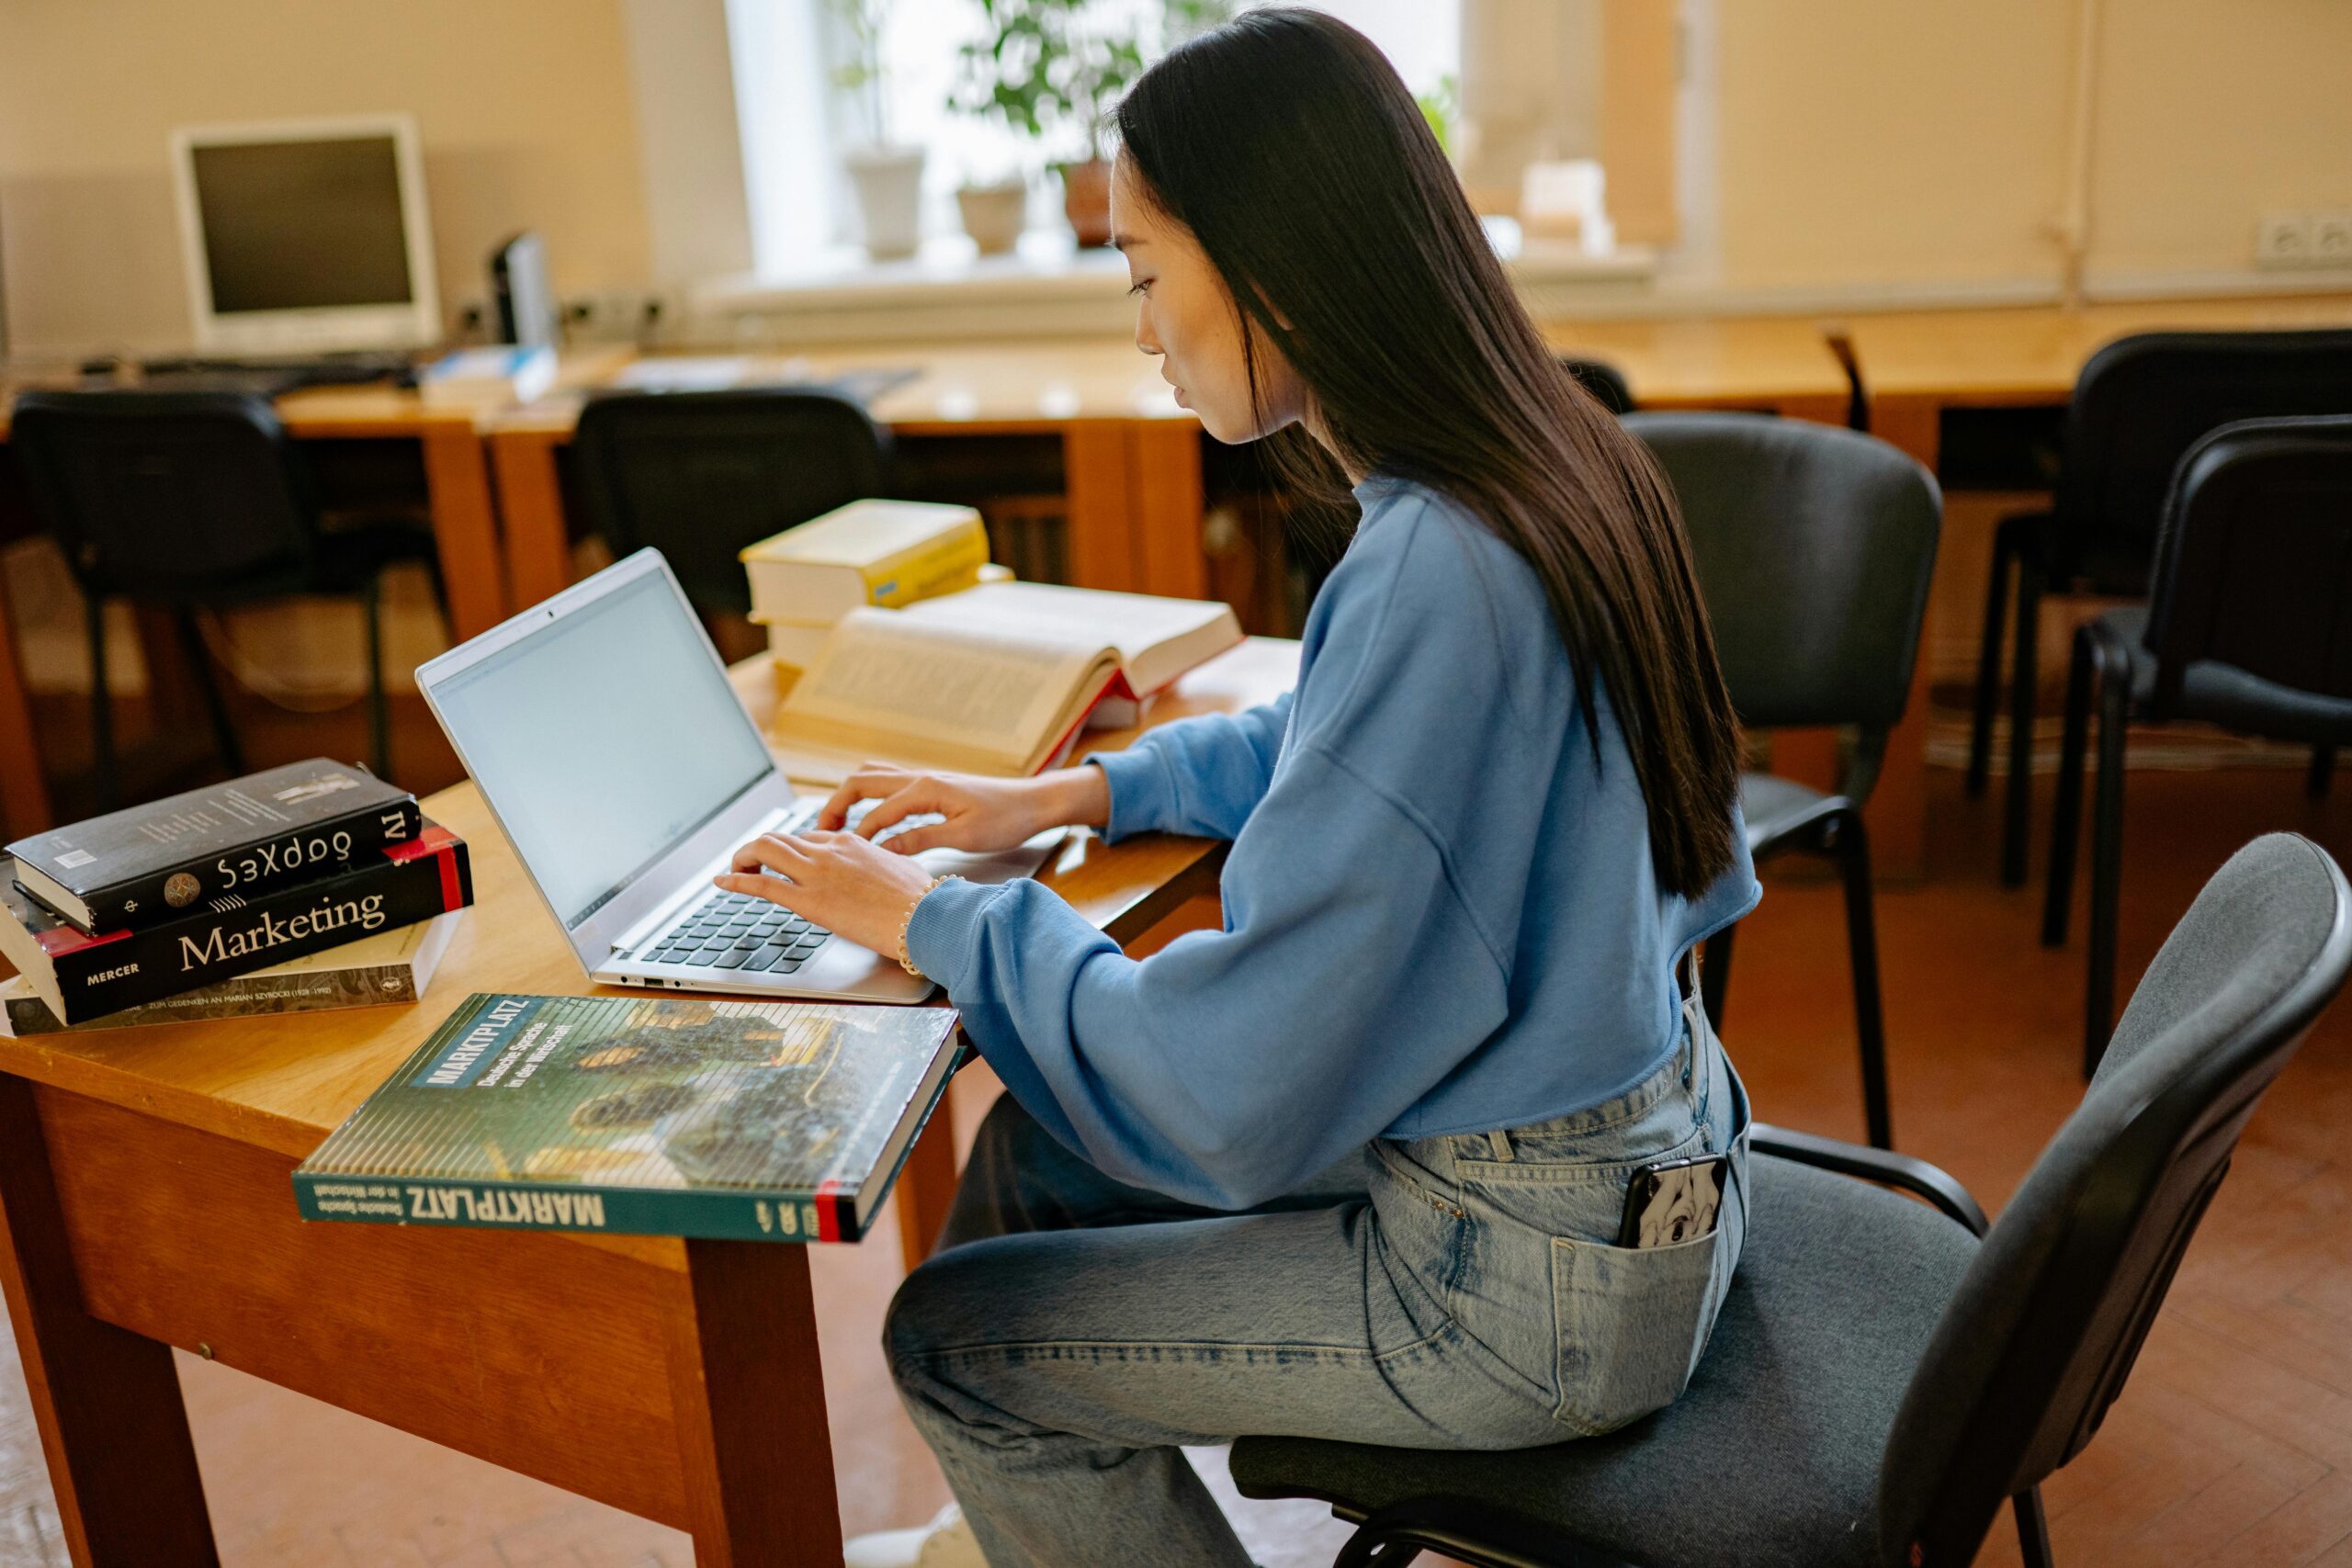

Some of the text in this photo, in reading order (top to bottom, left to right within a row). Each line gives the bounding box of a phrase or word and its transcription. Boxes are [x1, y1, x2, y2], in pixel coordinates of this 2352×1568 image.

[178, 893, 386, 972] Marketing
[87, 963, 140, 987] MERCER
[149, 1000, 166, 1010] ZUM
[168, 998, 209, 1008] GEDENKEN
[210, 996, 222, 1004] AN
[224, 993, 254, 1003] MARIAN
[255, 990, 290, 999] SZYROCKI
[426, 999, 530, 1085] MARKTPLATZ
[476, 1021, 548, 1087] Deutsche Sprache
[503, 1024, 574, 1089] in der Wirtschaft
[408, 1188, 605, 1226] MARKTPLATZ
